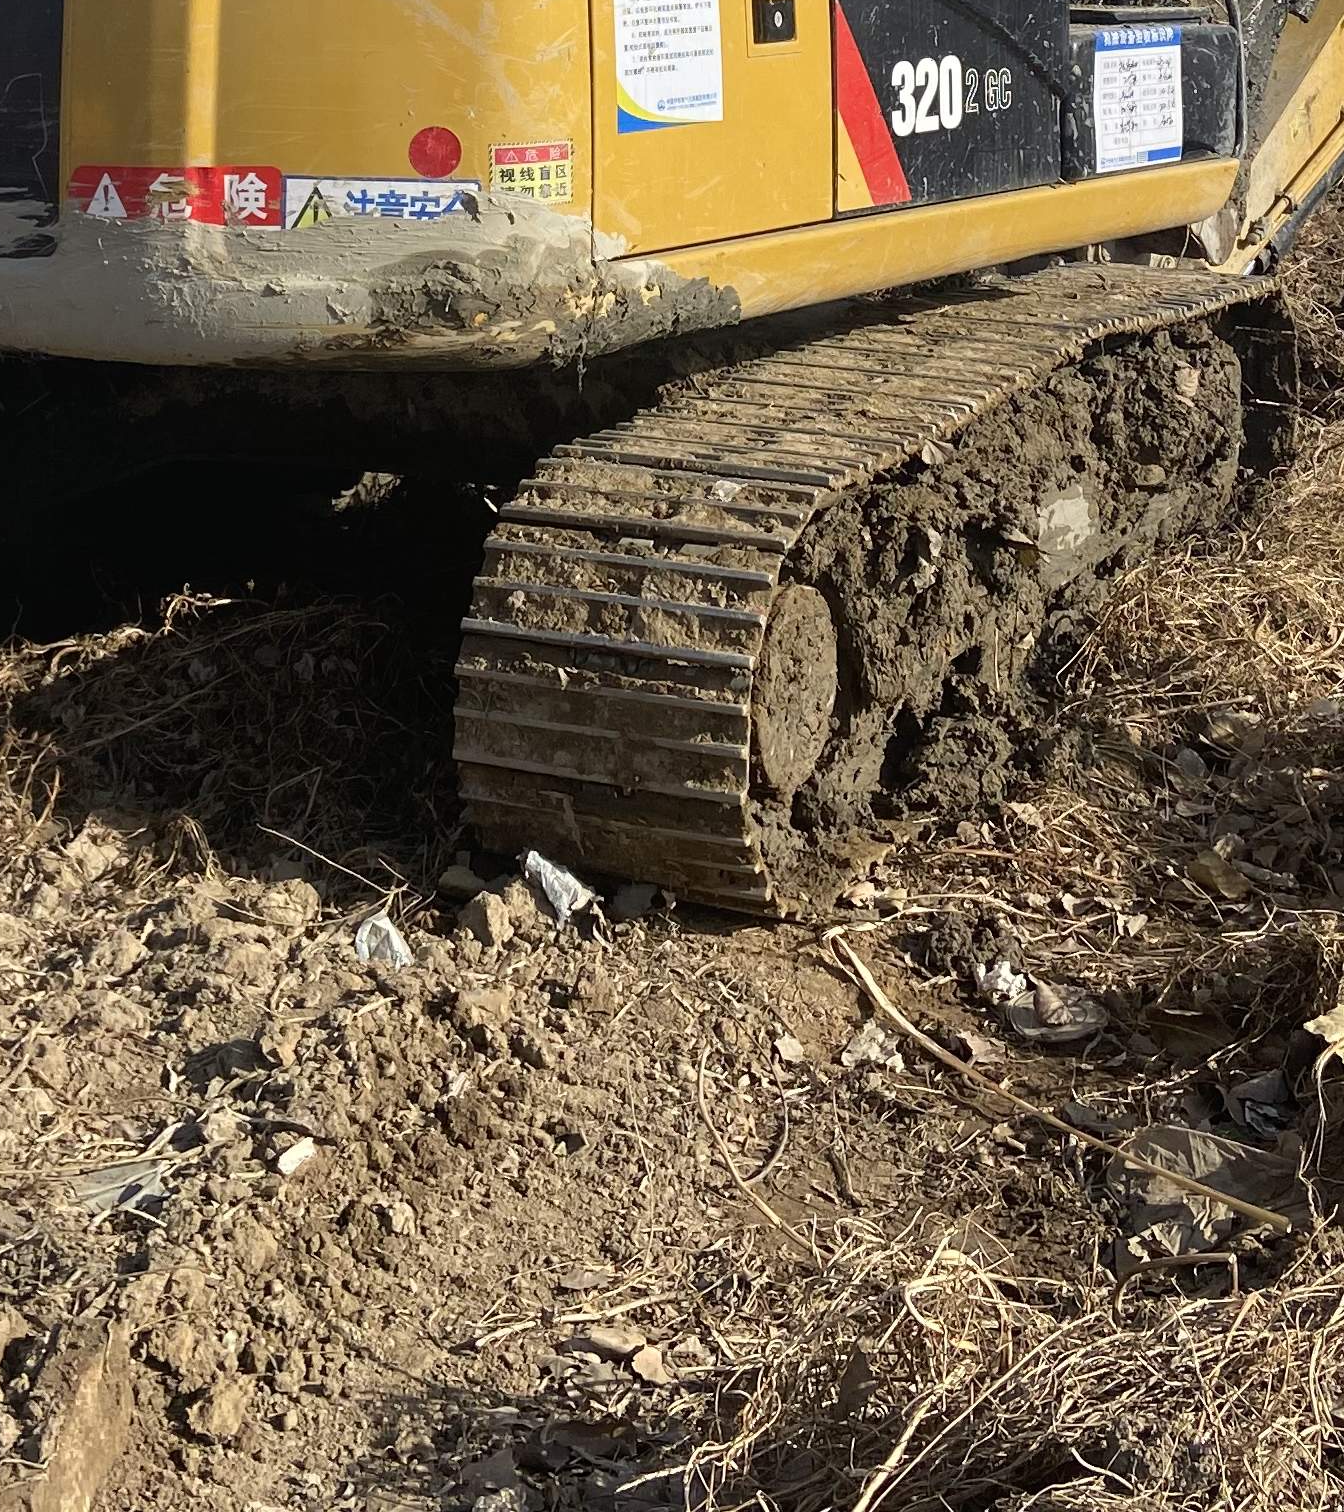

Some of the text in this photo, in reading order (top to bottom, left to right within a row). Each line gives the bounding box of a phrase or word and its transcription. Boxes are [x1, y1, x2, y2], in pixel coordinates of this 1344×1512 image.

[891, 54, 1012, 137] 320 2 GC
[498, 164, 568, 184] 视线盲区
